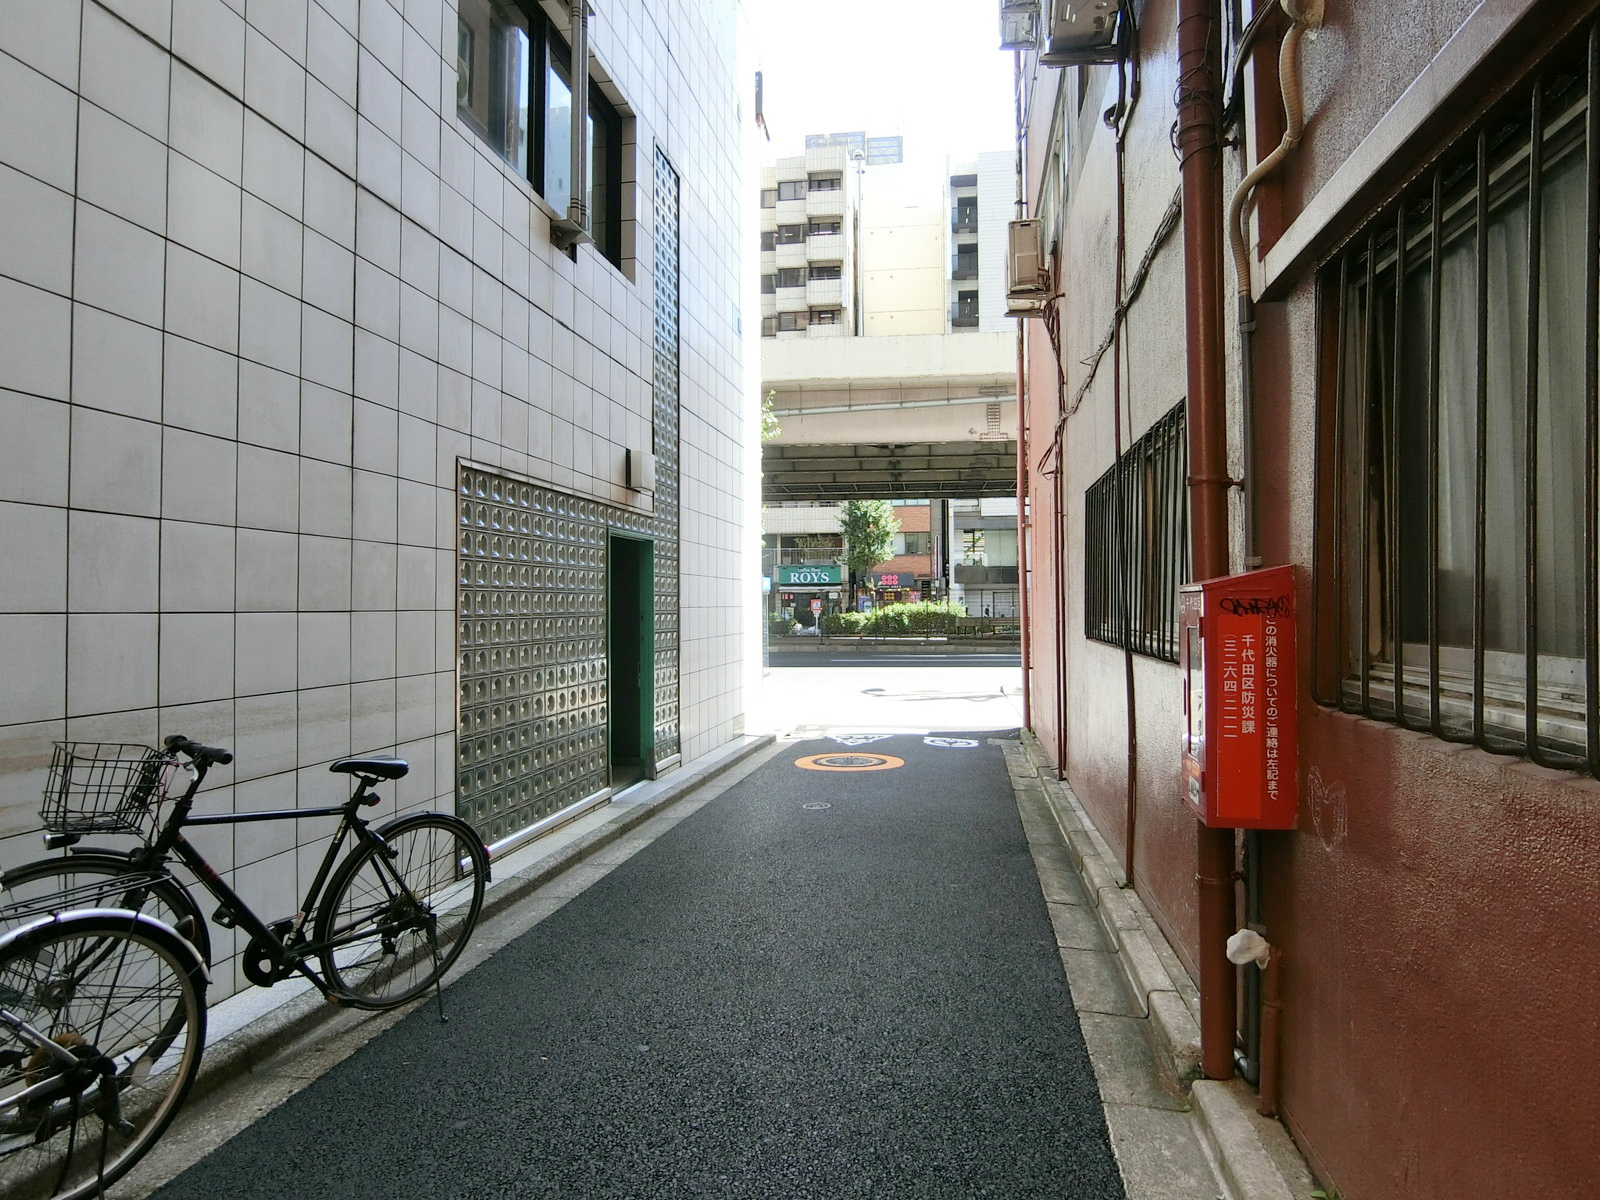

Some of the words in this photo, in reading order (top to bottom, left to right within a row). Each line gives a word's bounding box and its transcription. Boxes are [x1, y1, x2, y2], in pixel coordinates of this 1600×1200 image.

[790, 572, 830, 583] ROYS
[1241, 634, 1256, 734] 千代田区防災課
